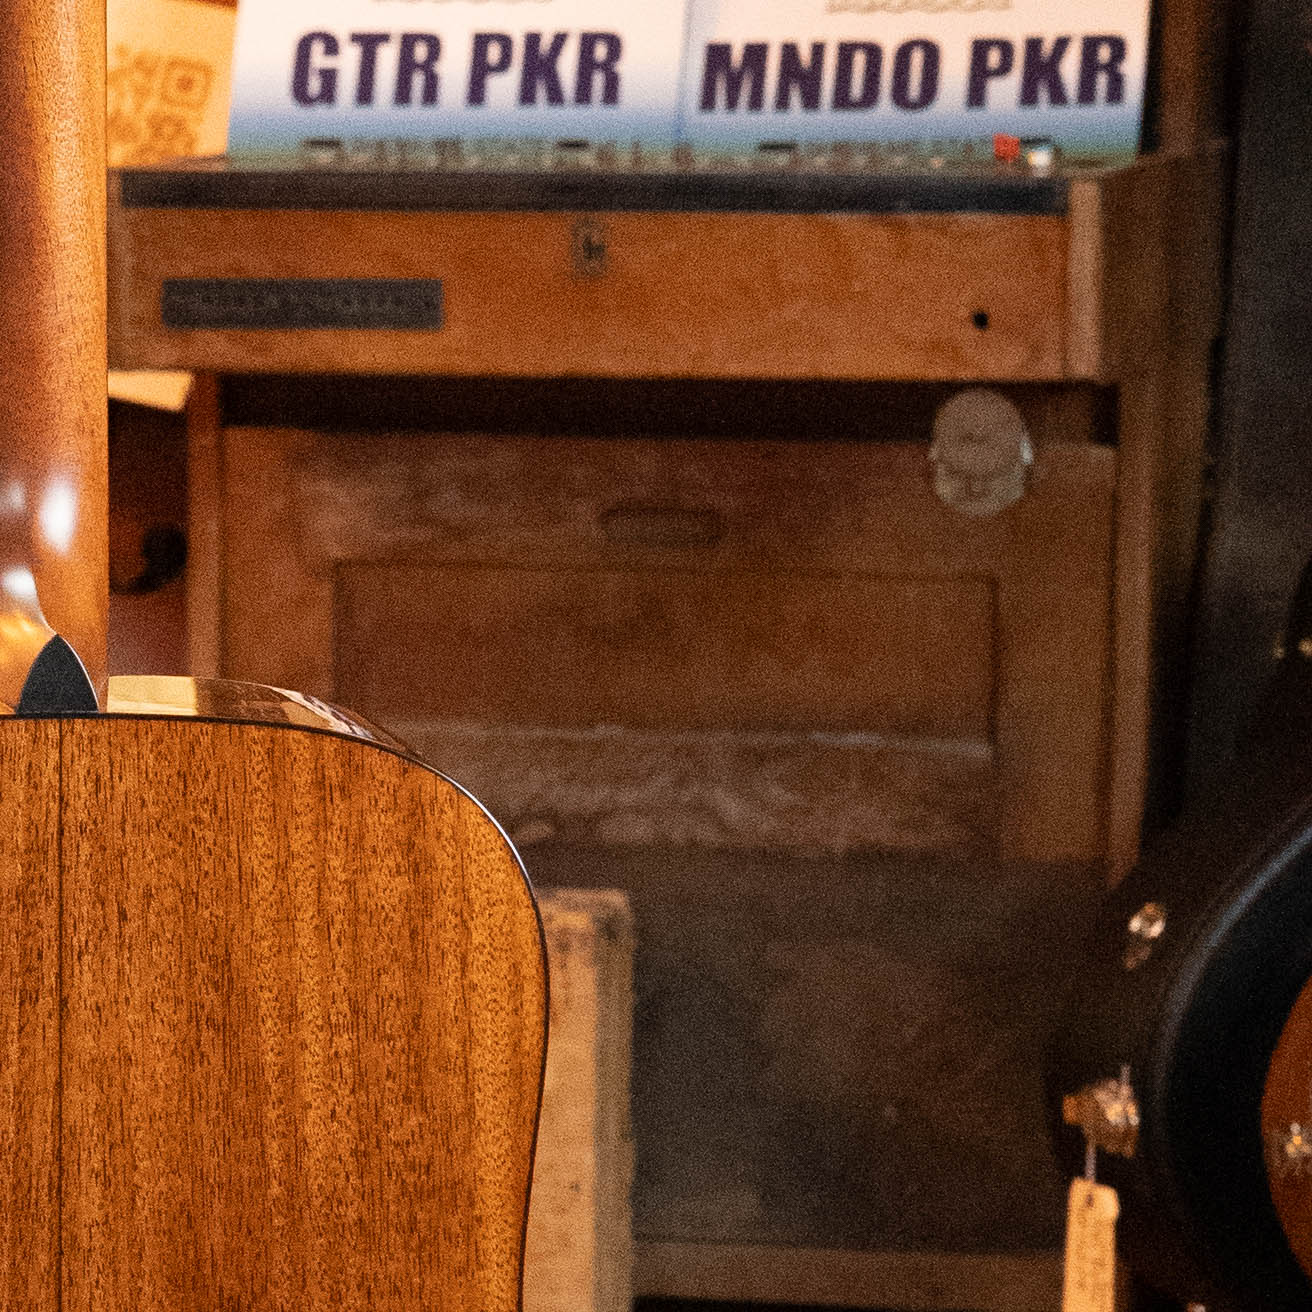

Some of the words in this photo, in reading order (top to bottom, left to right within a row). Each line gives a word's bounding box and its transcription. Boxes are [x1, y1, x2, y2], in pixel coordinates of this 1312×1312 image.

[290, 31, 443, 107] GTR
[464, 31, 623, 107] PKR
[699, 38, 941, 113] MNDO
[965, 34, 1128, 110] PKR
